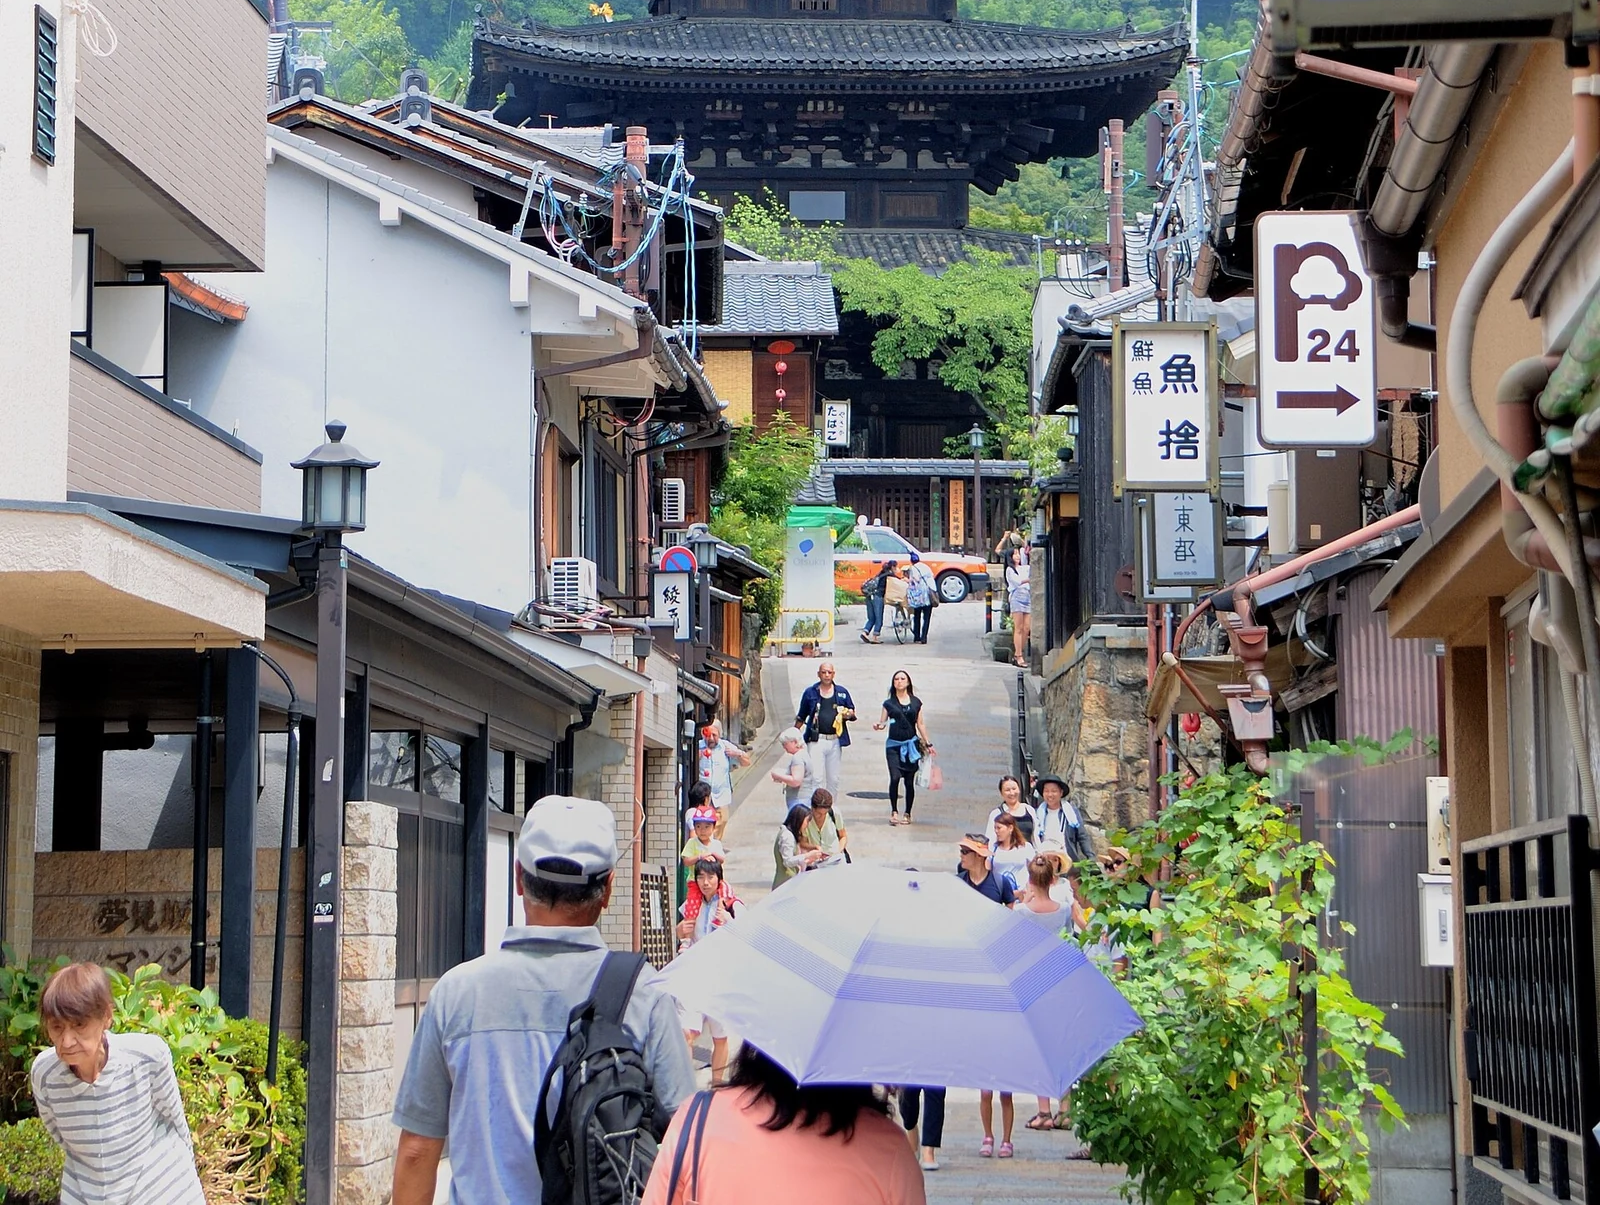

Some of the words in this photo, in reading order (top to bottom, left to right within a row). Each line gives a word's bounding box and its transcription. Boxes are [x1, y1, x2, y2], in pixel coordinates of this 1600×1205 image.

[1131, 340, 1154, 396] 鮮魚
[1306, 328, 1360, 363] 24
[1157, 353, 1200, 461] 魚捨
[1174, 493, 1197, 563] 東都
[97, 898, 210, 935] 夢見坂
